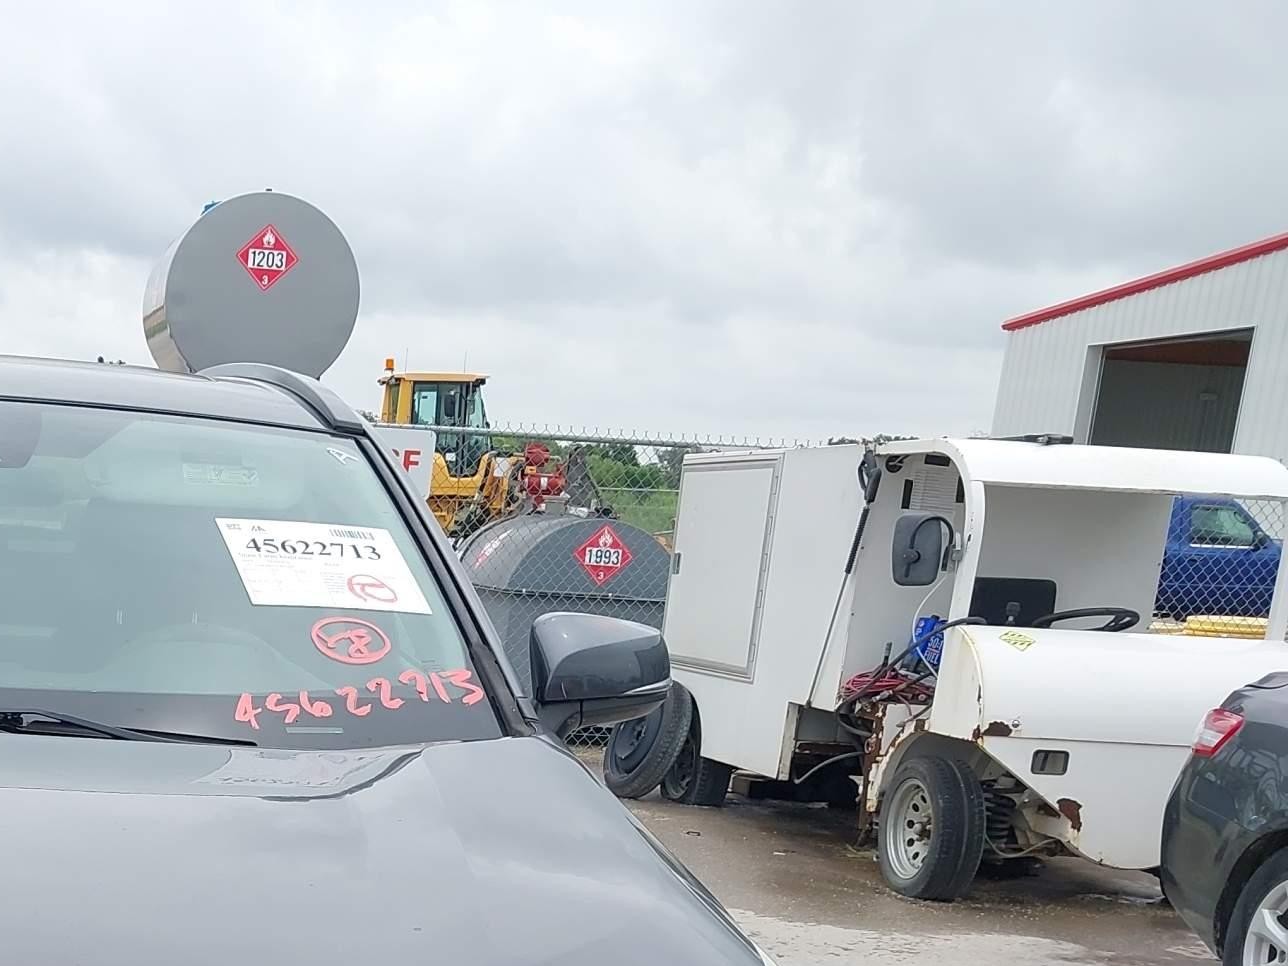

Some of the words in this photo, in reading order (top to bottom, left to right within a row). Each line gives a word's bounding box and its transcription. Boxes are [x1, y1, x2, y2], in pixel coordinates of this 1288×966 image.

[252, 250, 284, 269] 1203
[261, 274, 269, 285] 3
[245, 537, 382, 561] 45622713
[597, 571, 605, 580] 3
[234, 668, 485, 730] 45622713
